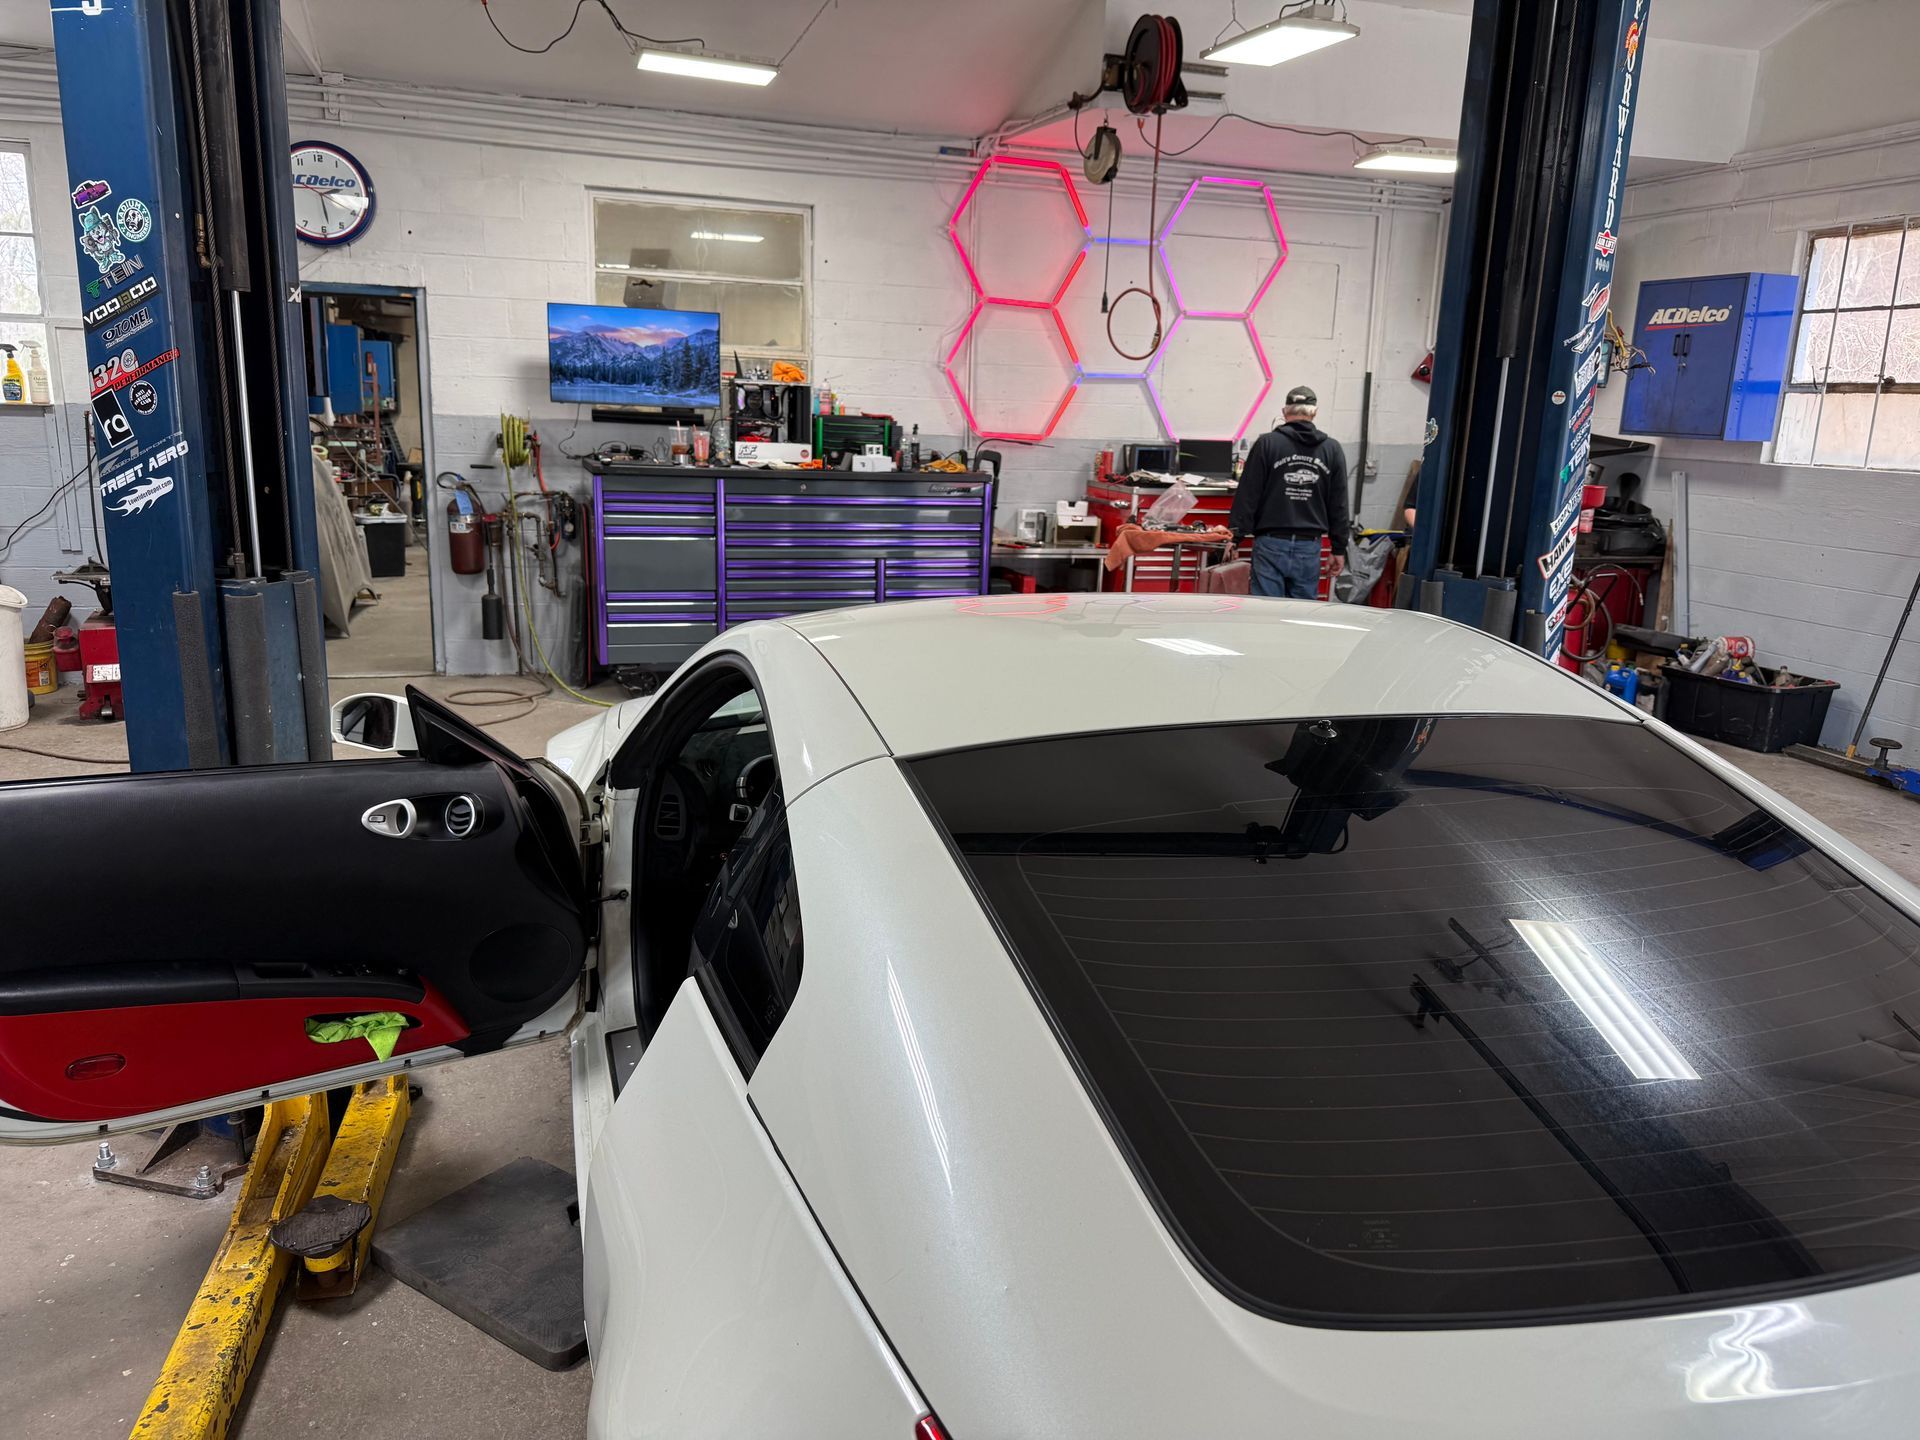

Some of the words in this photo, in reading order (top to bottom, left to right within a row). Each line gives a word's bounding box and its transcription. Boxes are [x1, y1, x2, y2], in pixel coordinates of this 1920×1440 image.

[297, 158, 304, 166] 11
[313, 154, 323, 163] 12
[118, 199, 141, 225] RADIUM
[302, 220, 309, 228] 7
[321, 225, 327, 234] 6
[338, 221, 345, 230] 5
[99, 254, 144, 289] TEIN
[1648, 305, 1731, 325] ACDelco
[113, 348, 180, 390] PERFORMANCE
[100, 462, 143, 497] TREET
[149, 440, 189, 473] AERO
[1541, 530, 1571, 573] HAWK
[1549, 551, 1574, 601] EXE
